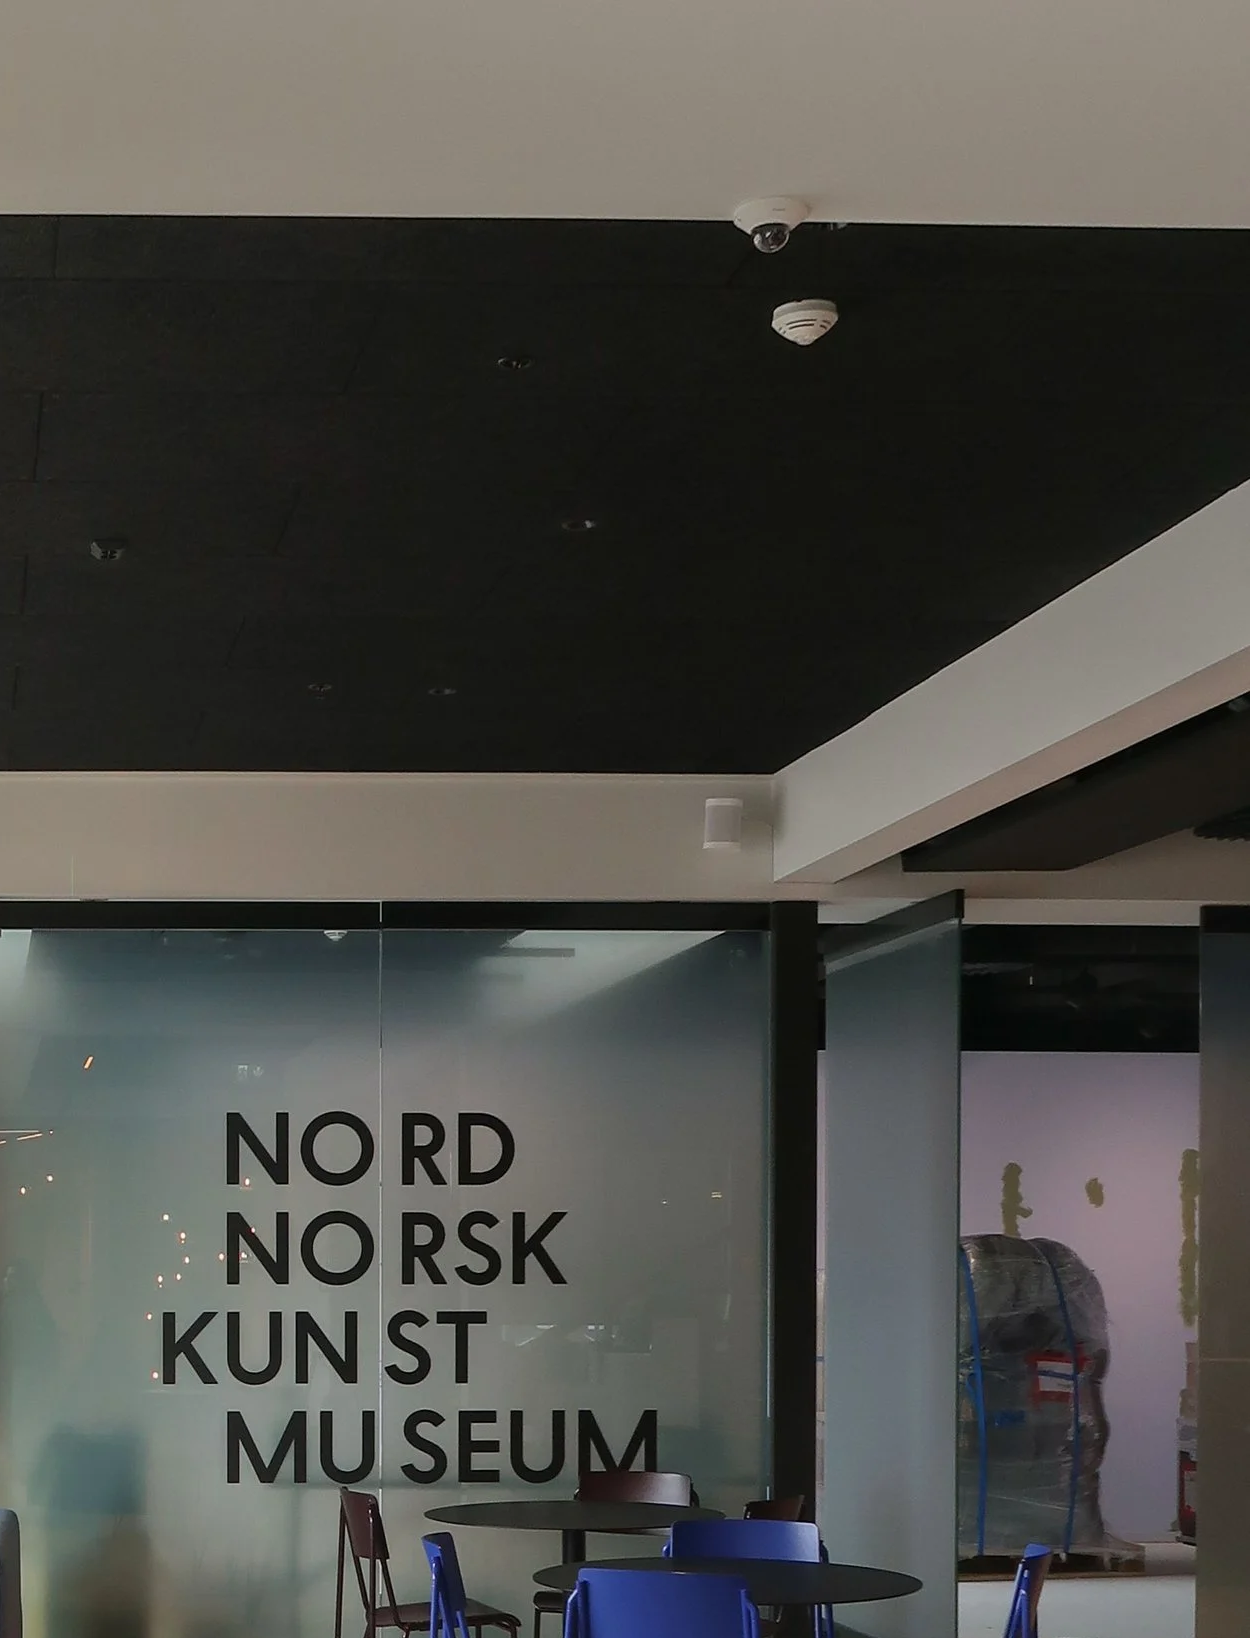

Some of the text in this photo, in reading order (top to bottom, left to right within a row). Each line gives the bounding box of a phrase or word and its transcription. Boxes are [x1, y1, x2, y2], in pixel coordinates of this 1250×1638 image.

[226, 1111, 515, 1186] NORD
[226, 1210, 568, 1285] NORSK
[162, 1310, 488, 1385] KUNST
[226, 1409, 658, 1485] MUSEUM
